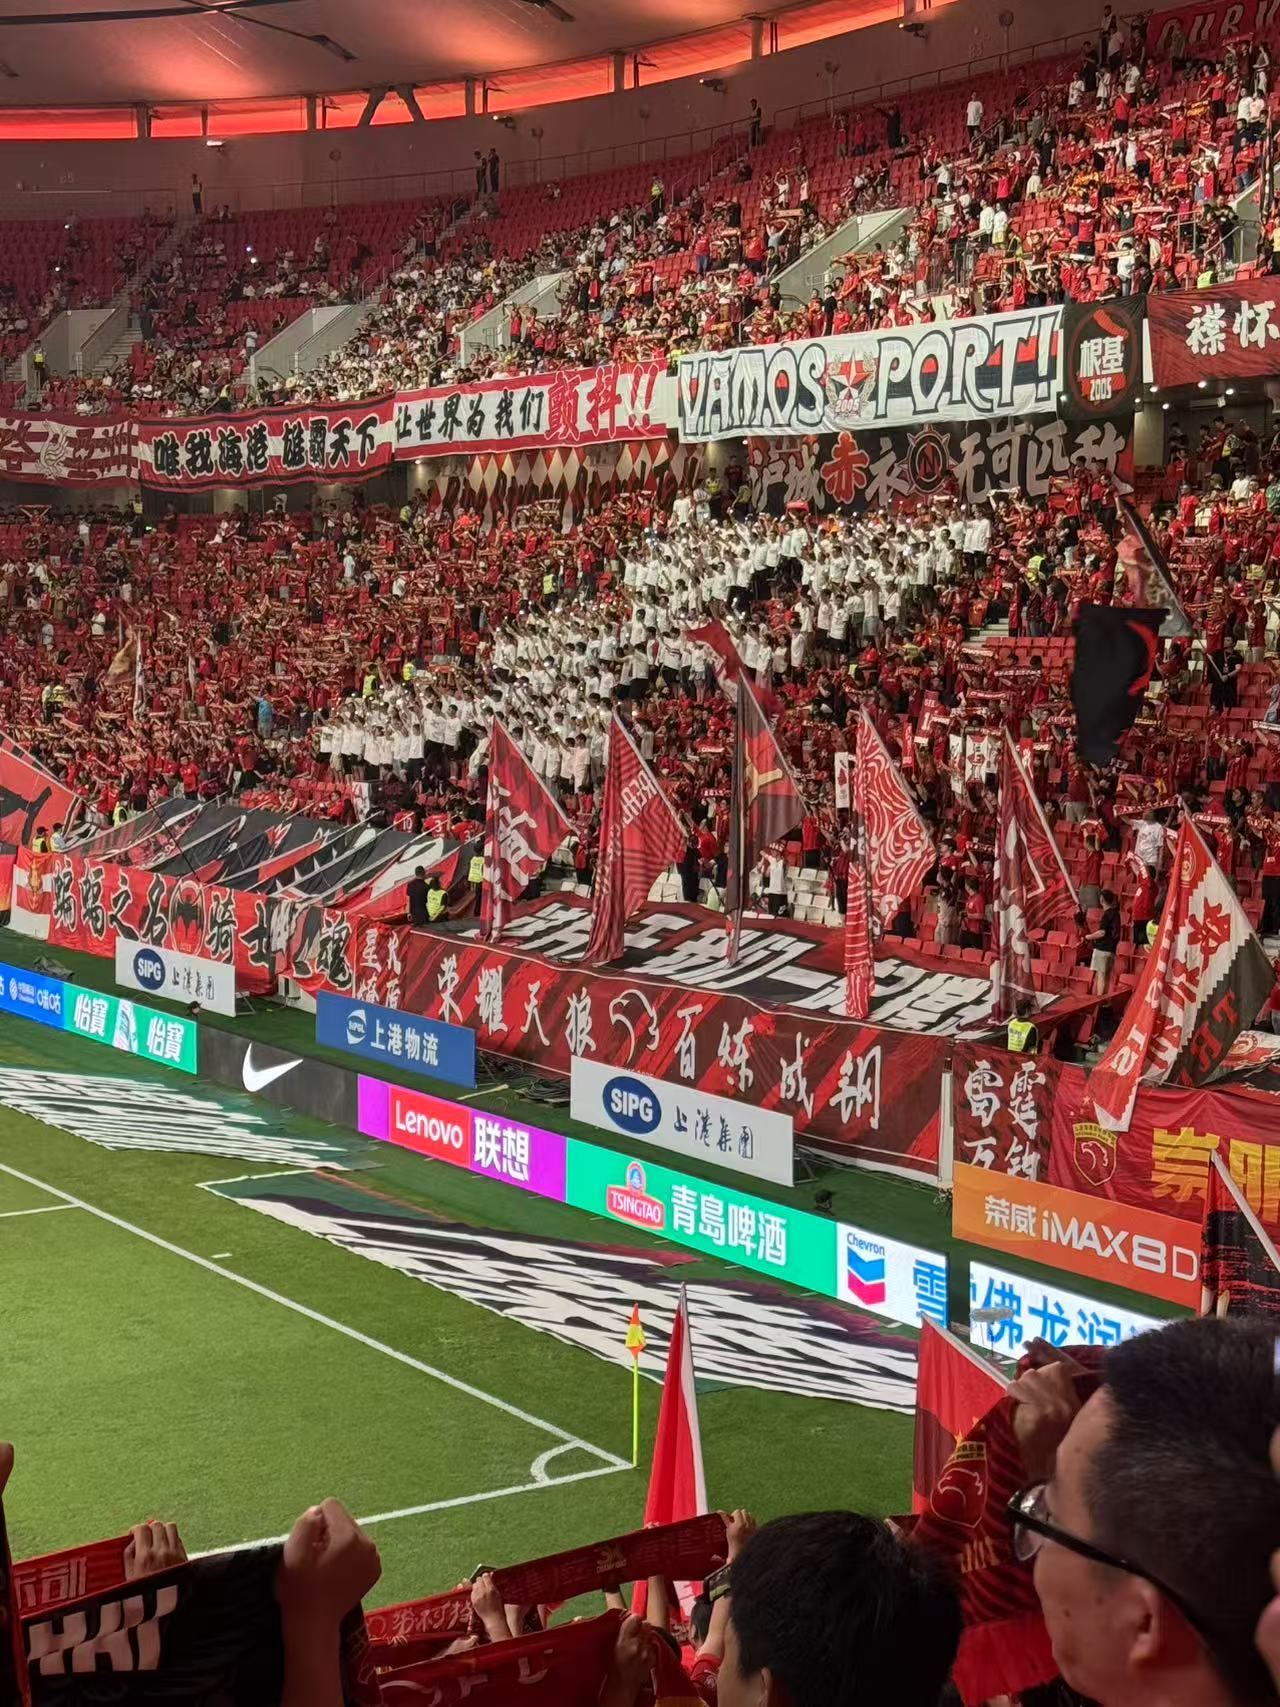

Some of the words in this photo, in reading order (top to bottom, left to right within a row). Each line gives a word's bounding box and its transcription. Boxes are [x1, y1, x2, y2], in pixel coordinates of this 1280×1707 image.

[680, 343, 827, 435] VAMOS
[875, 310, 1063, 418] PORT!
[1080, 336, 1124, 377] 根基
[835, 398, 859, 412] 2005
[153, 423, 269, 478] 唯我海港
[283, 415, 379, 468] 雄霸天下
[52, 857, 168, 946] 蝙蝠之名
[138, 957, 162, 982] SIPG
[370, 1019, 438, 1066] 上港物流
[396, 1099, 463, 1149] Lenovo
[611, 1088, 653, 1122] SIPG
[964, 1060, 1046, 1140] 雷霆
[474, 1116, 529, 1181] 联想
[611, 1190, 662, 1224] TSINGTAO
[847, 1233, 885, 1256] Chevron
[985, 1195, 1037, 1237] 荣威
[1042, 1210, 1166, 1274] iMAX8
